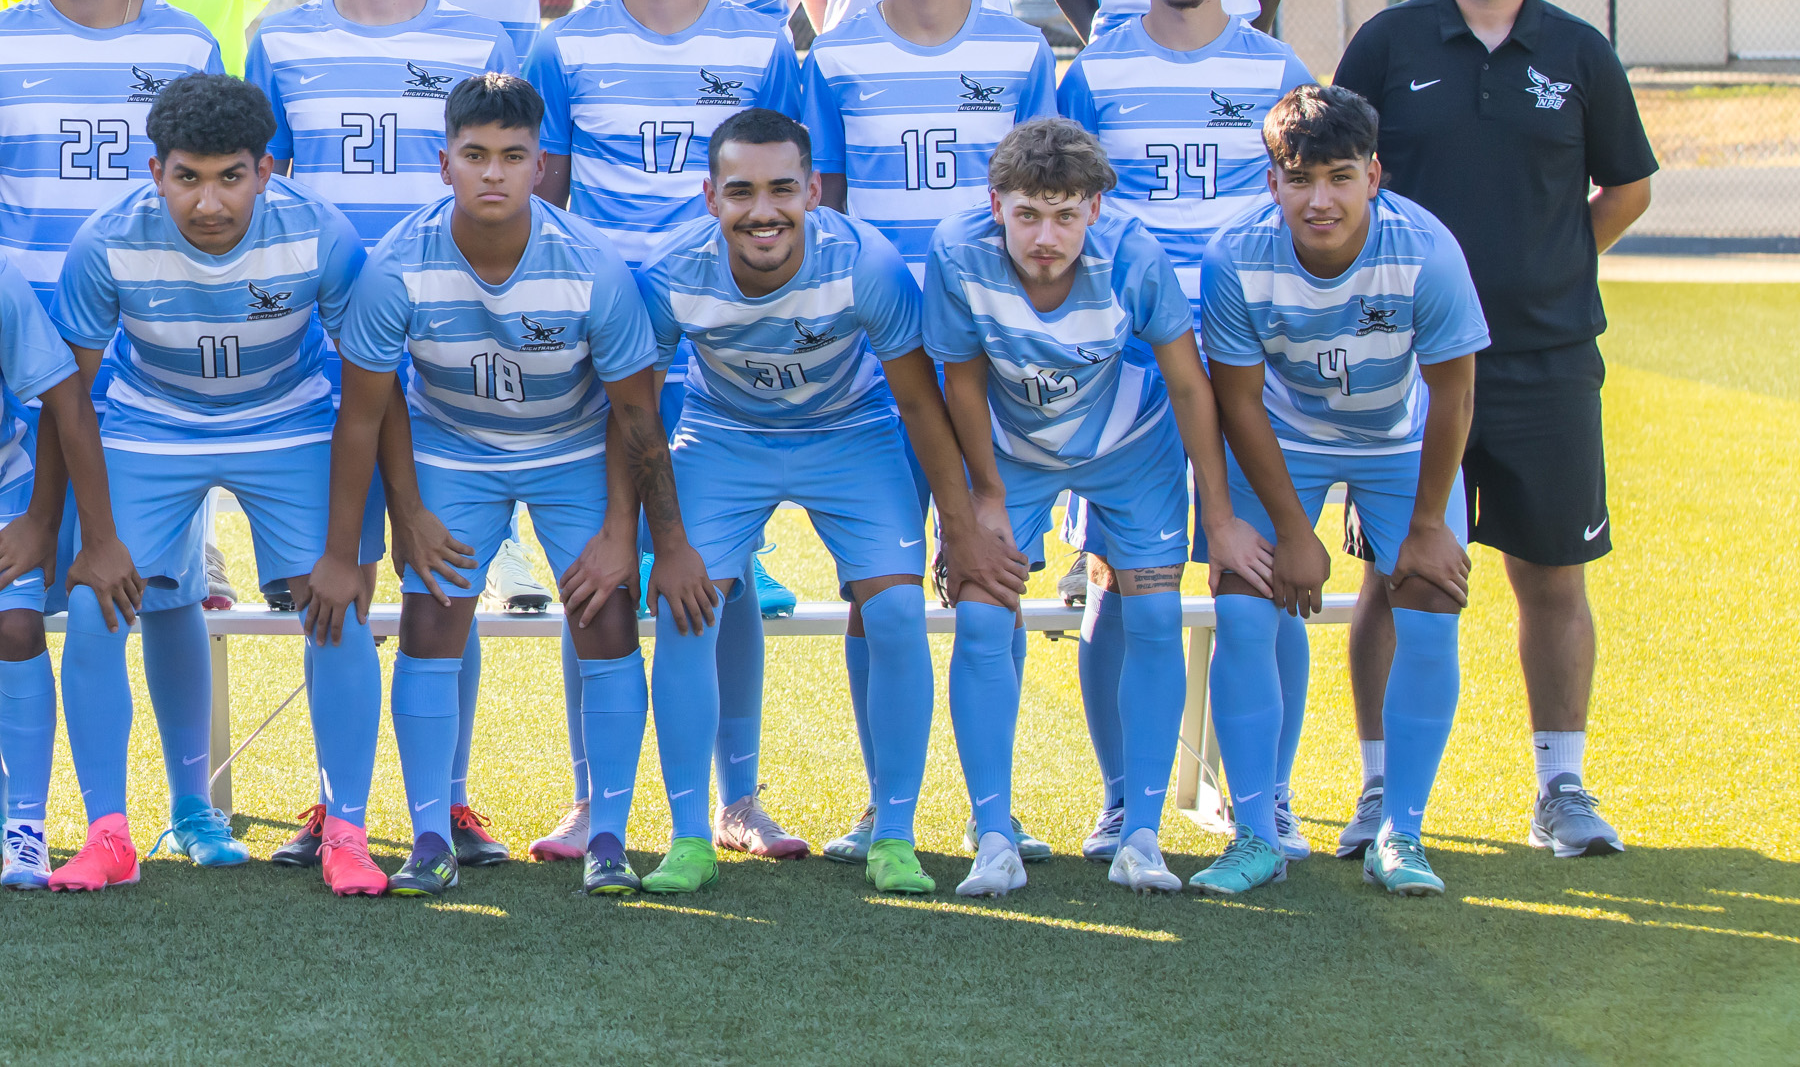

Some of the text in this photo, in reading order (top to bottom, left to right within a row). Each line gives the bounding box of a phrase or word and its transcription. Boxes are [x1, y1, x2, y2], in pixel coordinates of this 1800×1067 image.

[696, 97, 740, 105] NIGHTHAWKS
[958, 104, 1001, 112] NIGHTHAWKS
[1536, 97, 1567, 109] NPC
[341, 112, 397, 174] 21
[1207, 120, 1253, 128] NIGHTHAWKS
[60, 119, 130, 180] 22
[639, 120, 694, 173] 17
[901, 128, 957, 190] 16
[1145, 143, 1218, 201] 34
[247, 309, 292, 321] NIGHTHAWKS
[1356, 324, 1397, 337] NIGHTHAWKS
[197, 335, 240, 379] 11
[520, 342, 564, 351] NIGHTHAWKS
[471, 352, 525, 402] 18
[744, 359, 809, 391] 31
[1317, 348, 1350, 397] 4
